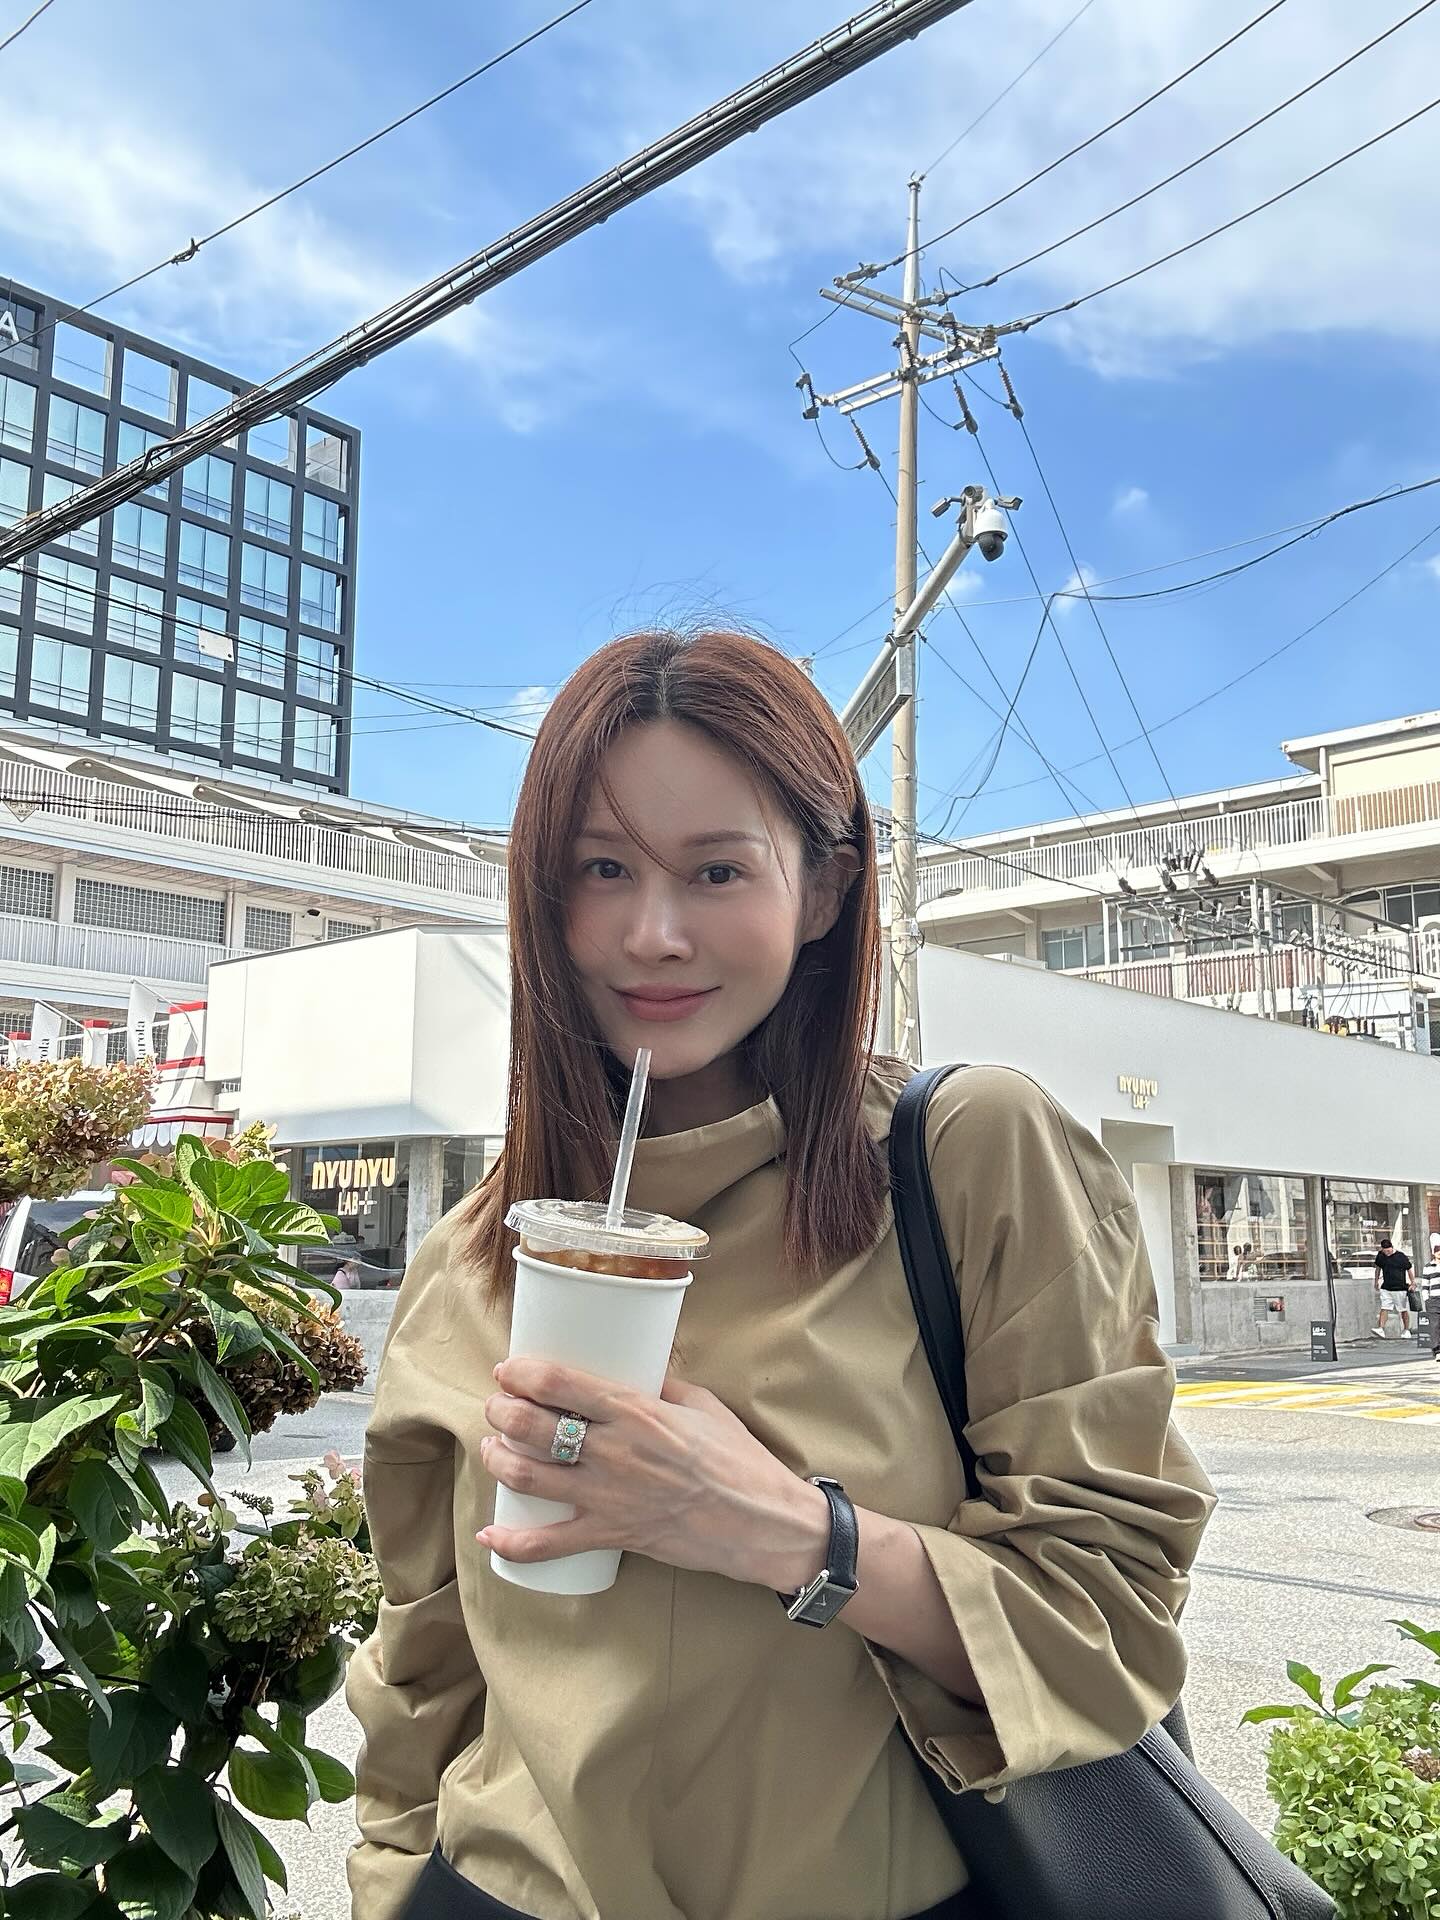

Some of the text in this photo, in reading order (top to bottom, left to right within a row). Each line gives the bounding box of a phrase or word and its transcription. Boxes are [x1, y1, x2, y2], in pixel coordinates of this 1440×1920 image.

[0, 310, 20, 342] A
[39, 1038, 50, 1062] rola
[337, 1190, 377, 1216] LAB+
